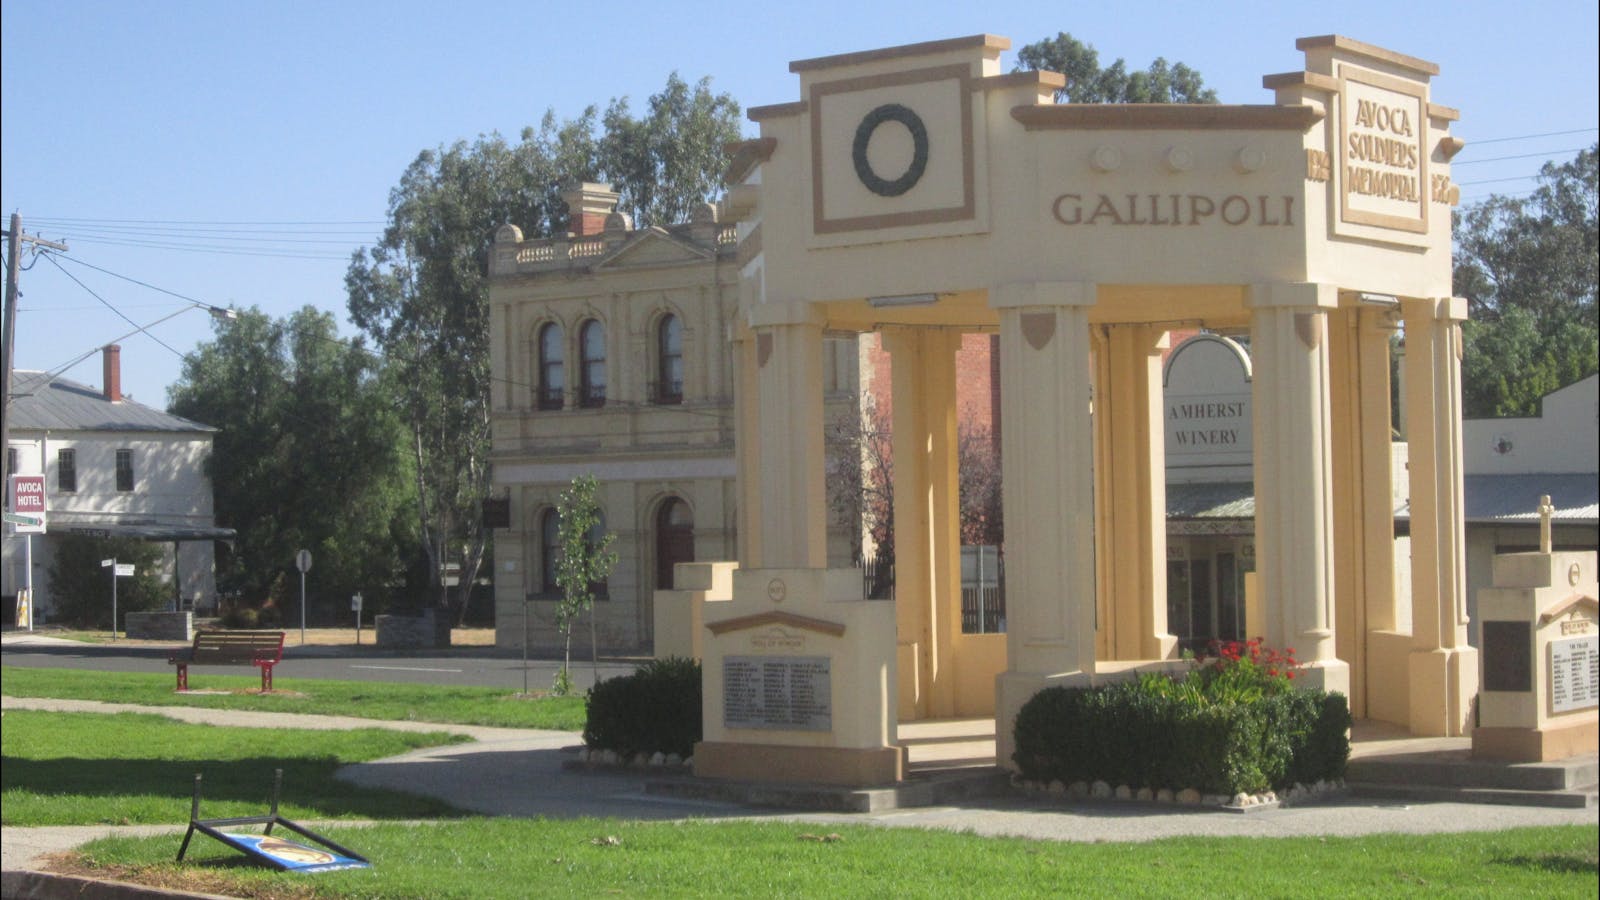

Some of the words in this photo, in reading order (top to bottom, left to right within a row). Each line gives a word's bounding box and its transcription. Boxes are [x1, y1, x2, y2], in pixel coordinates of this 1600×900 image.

[1355, 99, 1413, 137] AVOCA
[1349, 131, 1418, 170] SOLDIERS
[1347, 166, 1419, 203] MEMORIAL
[1052, 194, 1295, 226] GALLIPOLI
[1169, 402, 1246, 420] AMHERST
[1175, 429, 1239, 445] WINERY
[17, 482, 42, 493] AVOCA
[18, 496, 41, 506] HOTEL
